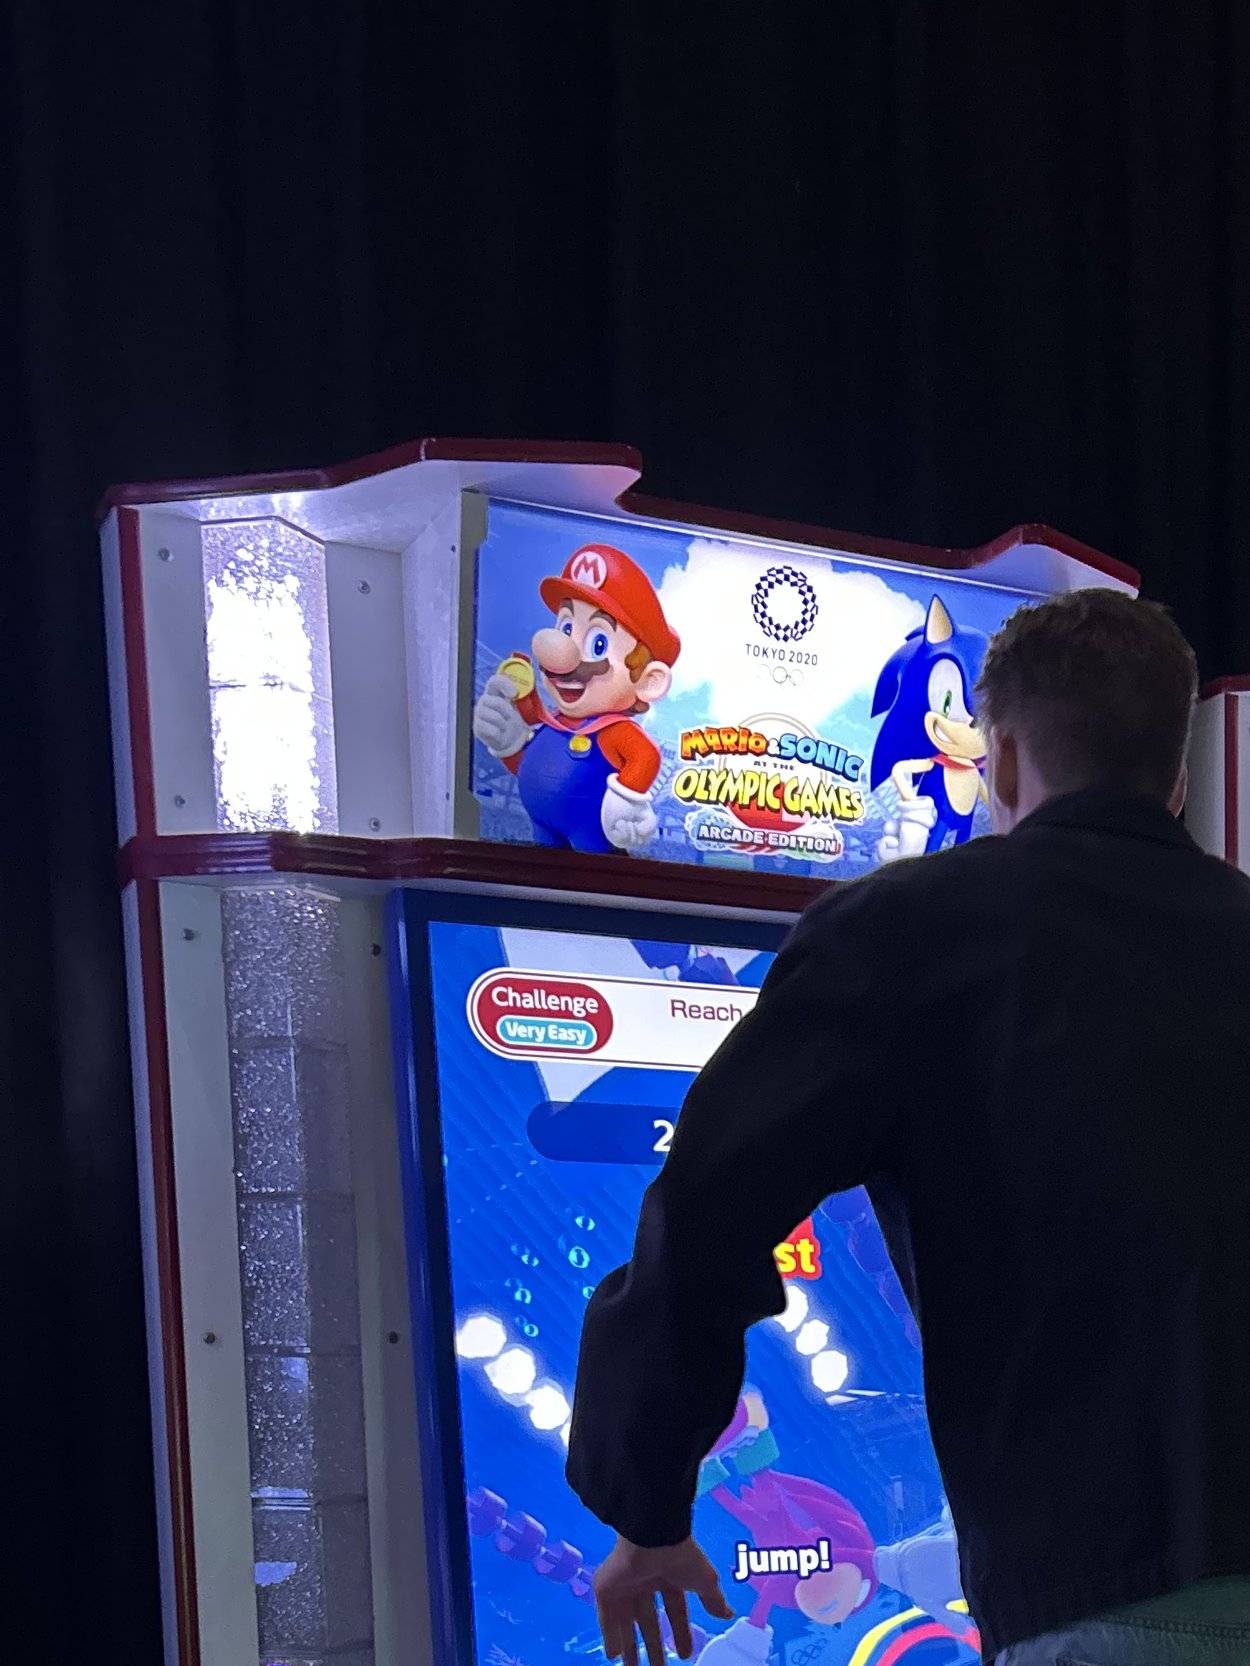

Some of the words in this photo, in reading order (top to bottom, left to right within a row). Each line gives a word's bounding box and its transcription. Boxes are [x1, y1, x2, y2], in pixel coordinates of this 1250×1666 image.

[745, 643, 785, 661] TOKYO
[789, 649, 818, 666] 2020
[680, 725, 768, 761] MARIO
[778, 732, 865, 782] SONIC
[772, 762, 796, 771] THE
[674, 767, 784, 812] OLYMPIC
[781, 774, 865, 822] GAMES
[697, 824, 765, 847] ARCADE
[767, 831, 837, 852] EDITION
[490, 985, 599, 1017] Challenge
[670, 999, 743, 1021] Reach
[505, 1020, 545, 1043] Very
[547, 1024, 588, 1046] Easy
[653, 1119, 674, 1152] 2
[773, 1238, 816, 1273] st
[735, 1541, 830, 1581] jump!
